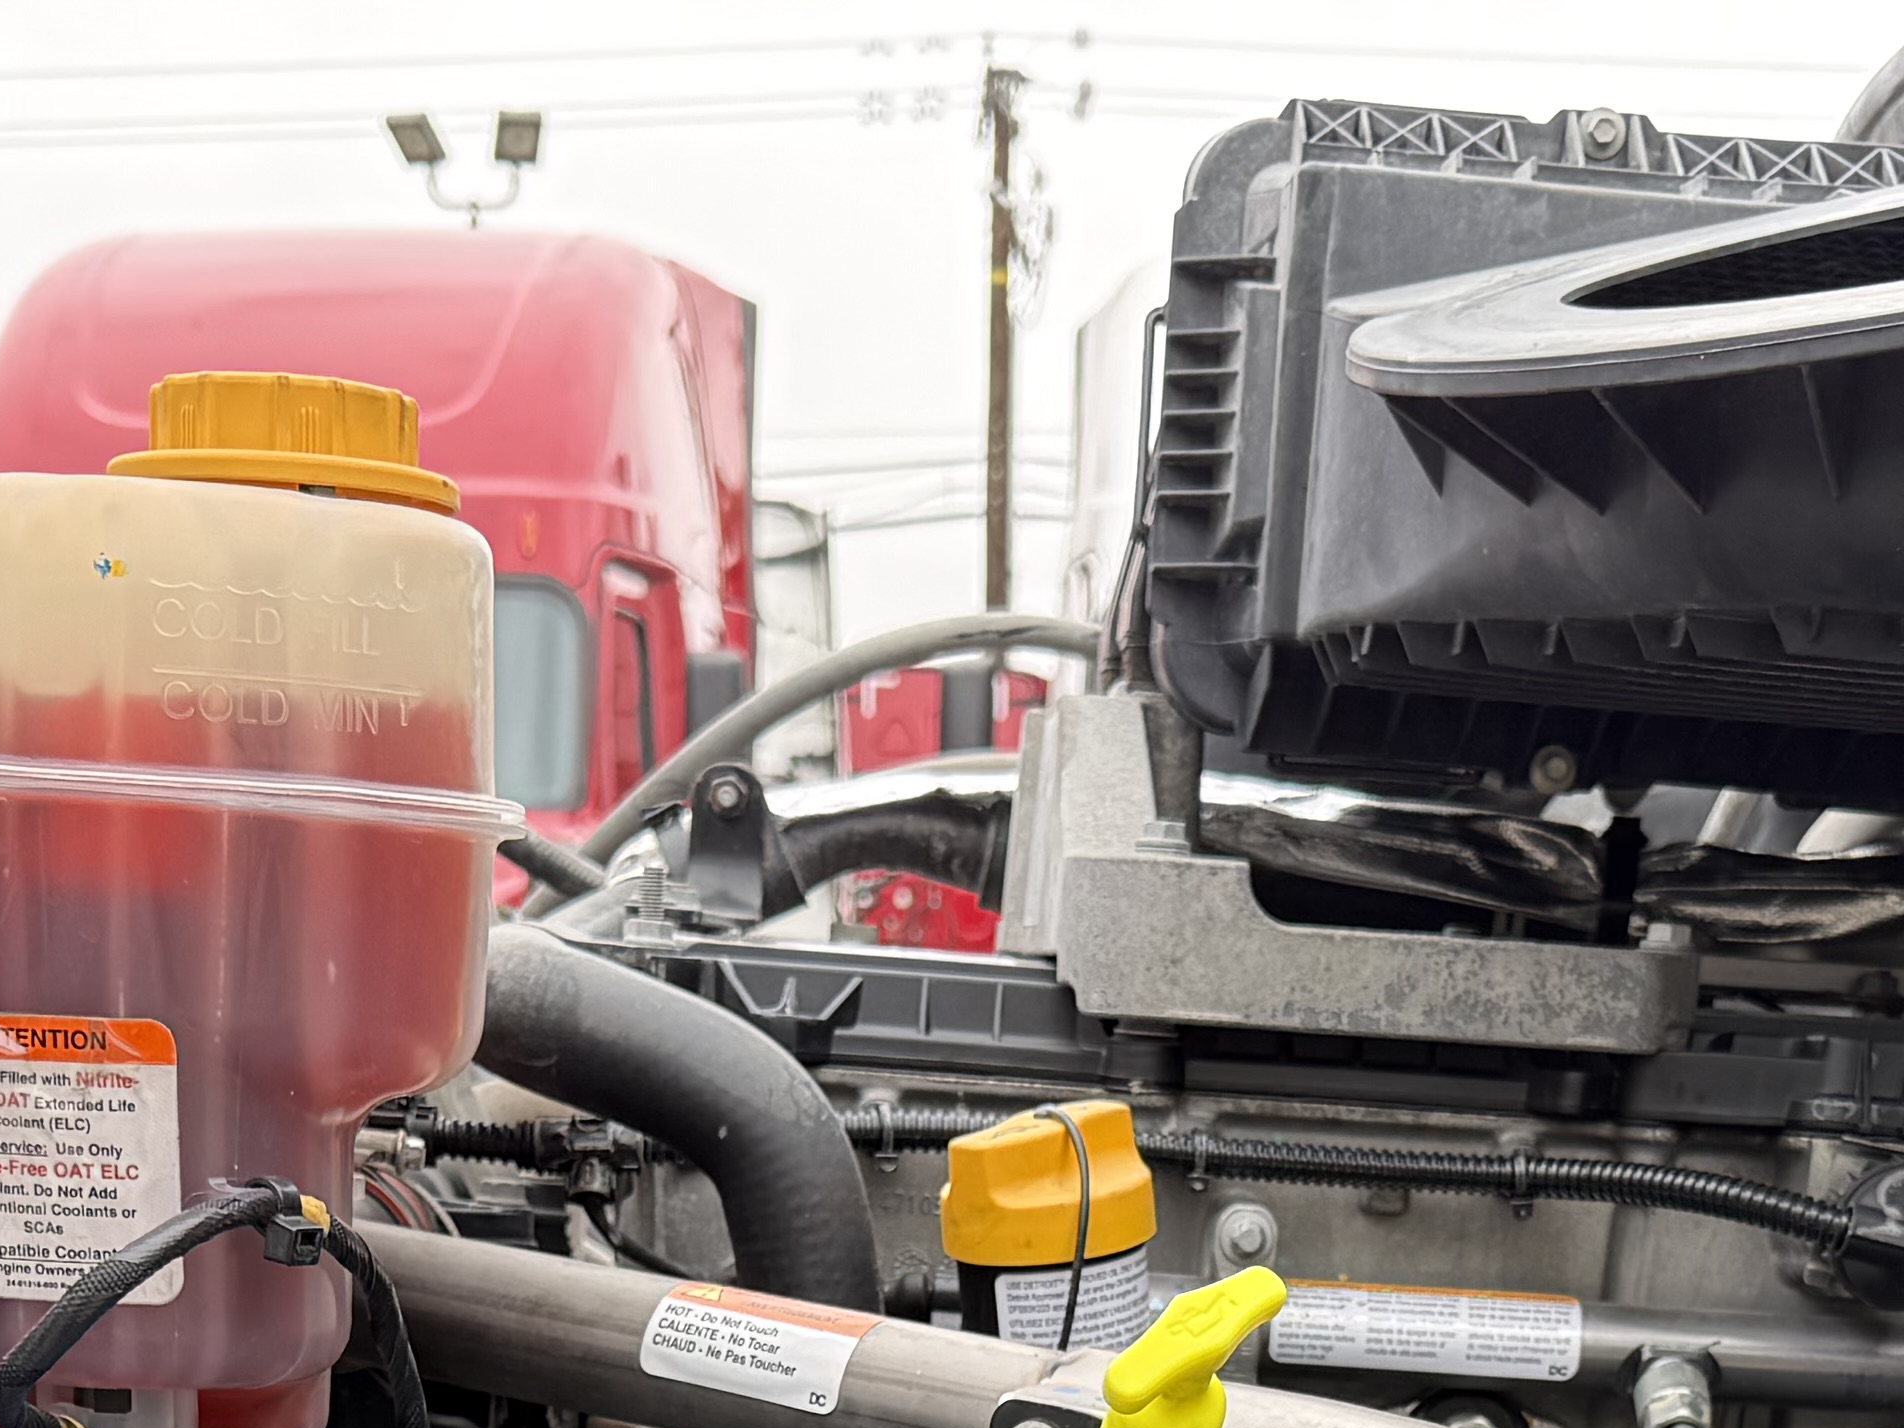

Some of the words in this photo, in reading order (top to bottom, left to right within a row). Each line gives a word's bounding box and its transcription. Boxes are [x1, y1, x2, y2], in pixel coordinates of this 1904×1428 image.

[153, 598, 284, 645] COLD
[162, 680, 290, 726] COLD
[0, 1071, 37, 1086] Filled
[40, 1073, 71, 1087] with
[34, 1096, 104, 1112] Extended
[108, 1099, 136, 1113] Life
[49, 1117, 91, 1134] (ELC)
[55, 1142, 84, 1156] Use
[88, 1143, 123, 1160] Only
[53, 1162, 94, 1180] OAT
[100, 1164, 140, 1180] ELC
[34, 1184, 53, 1198] Do
[58, 1185, 83, 1199] Not
[88, 1186, 117, 1200] Add
[51, 1203, 117, 1218] Coolants
[122, 1207, 137, 1219] or
[23, 1221, 64, 1236] SCAs
[55, 1247, 118, 1262] Coolant
[665, 1303, 694, 1318] HOT
[701, 1311, 718, 1324] Do
[721, 1315, 743, 1330] Not
[745, 1320, 779, 1338] Touch
[658, 1317, 717, 1342] CALIENTE
[727, 1333, 745, 1348] No
[748, 1337, 781, 1356] Tocar
[652, 1333, 696, 1354] CHAUD
[705, 1345, 722, 1360] Ne
[724, 1349, 746, 1366] Pas
[749, 1355, 797, 1378] Toucher
[809, 1392, 827, 1407] DC
